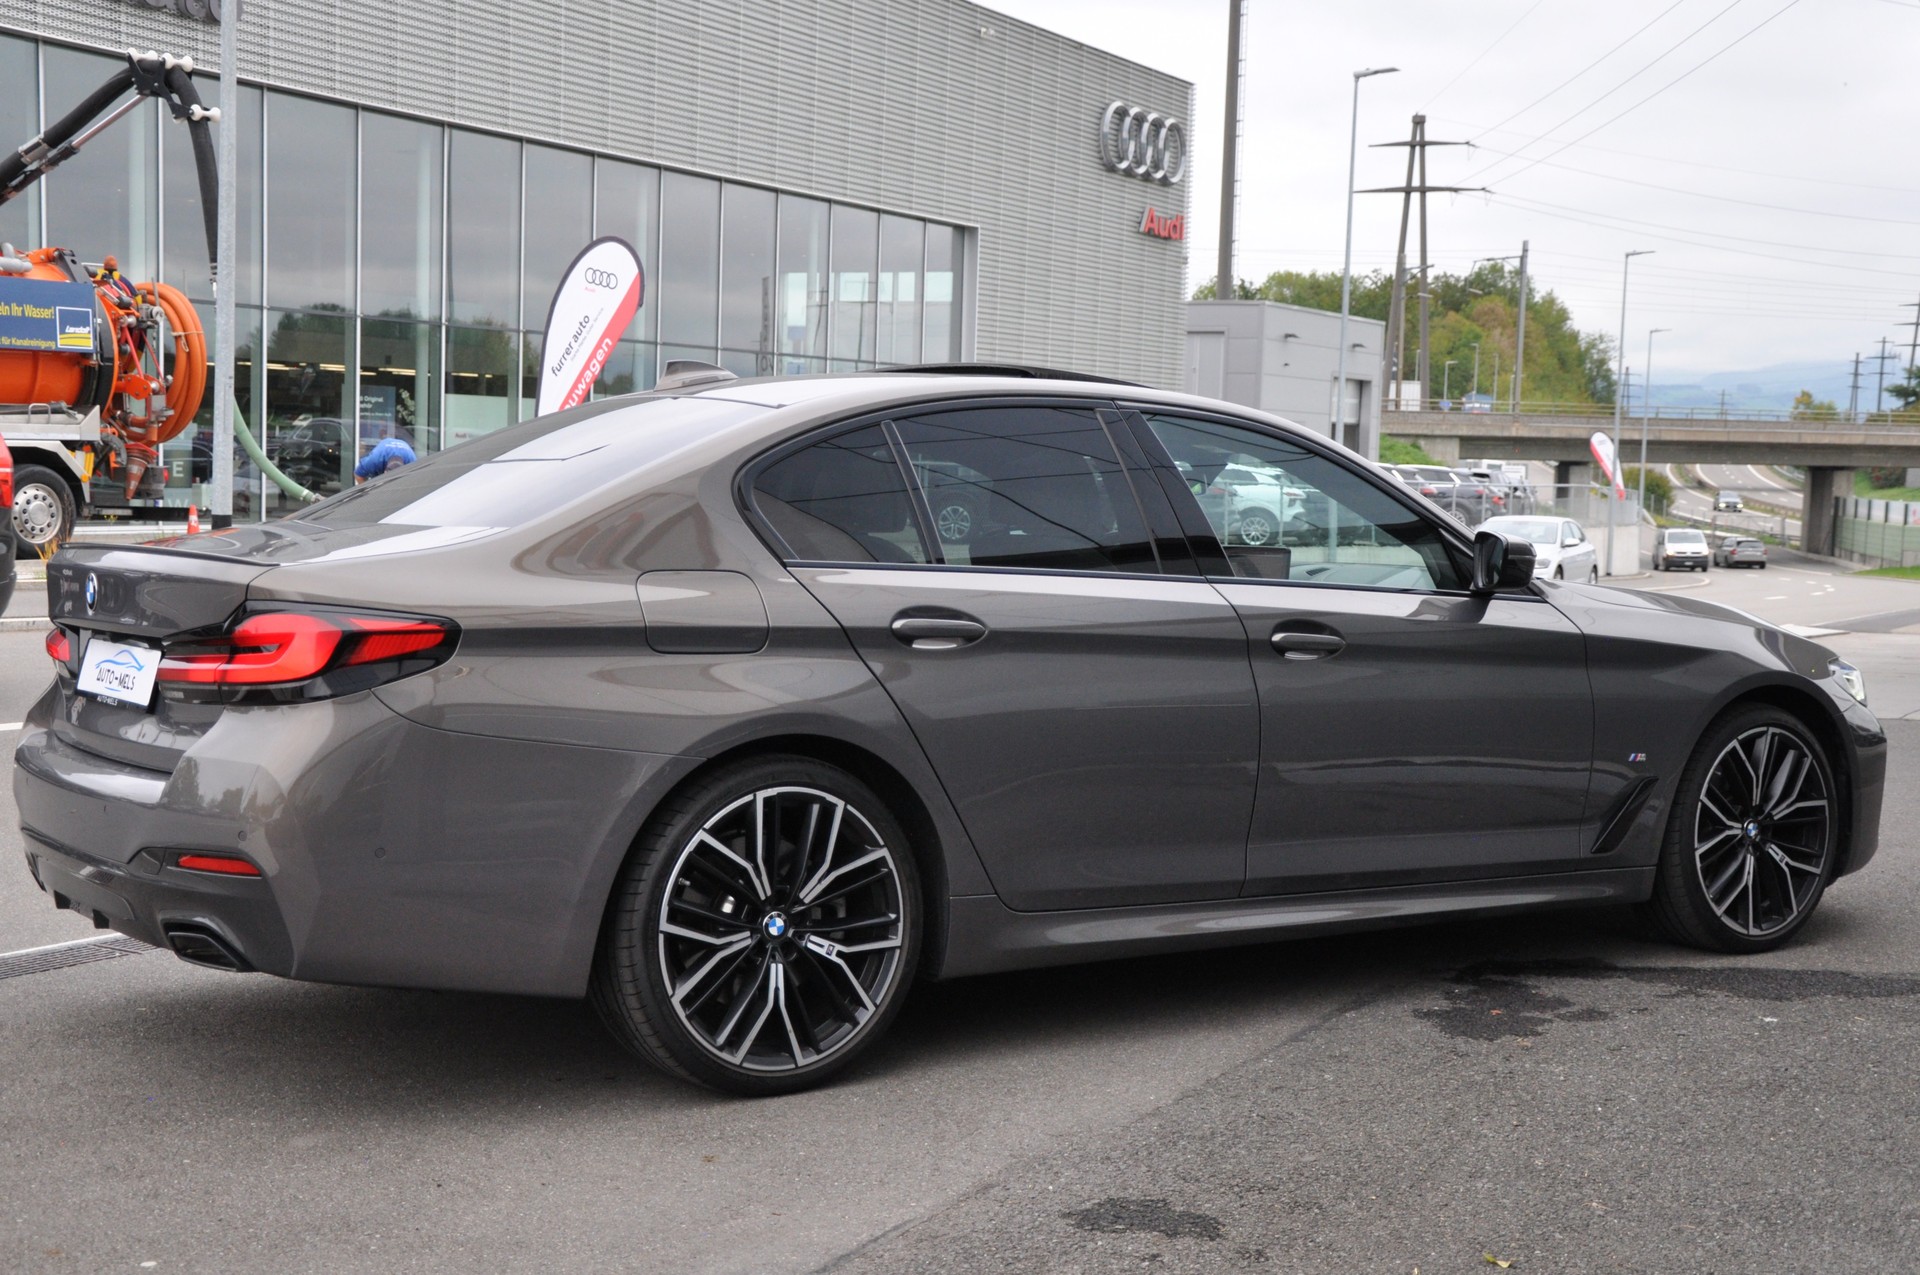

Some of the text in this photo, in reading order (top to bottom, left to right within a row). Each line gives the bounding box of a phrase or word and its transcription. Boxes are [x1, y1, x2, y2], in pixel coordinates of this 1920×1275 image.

[1142, 206, 1184, 241] Audi
[11, 303, 22, 316] Ihr
[23, 304, 55, 319] Wasser!
[551, 314, 591, 377] furrer auto
[96, 667, 135, 690] AUTO-MELS
